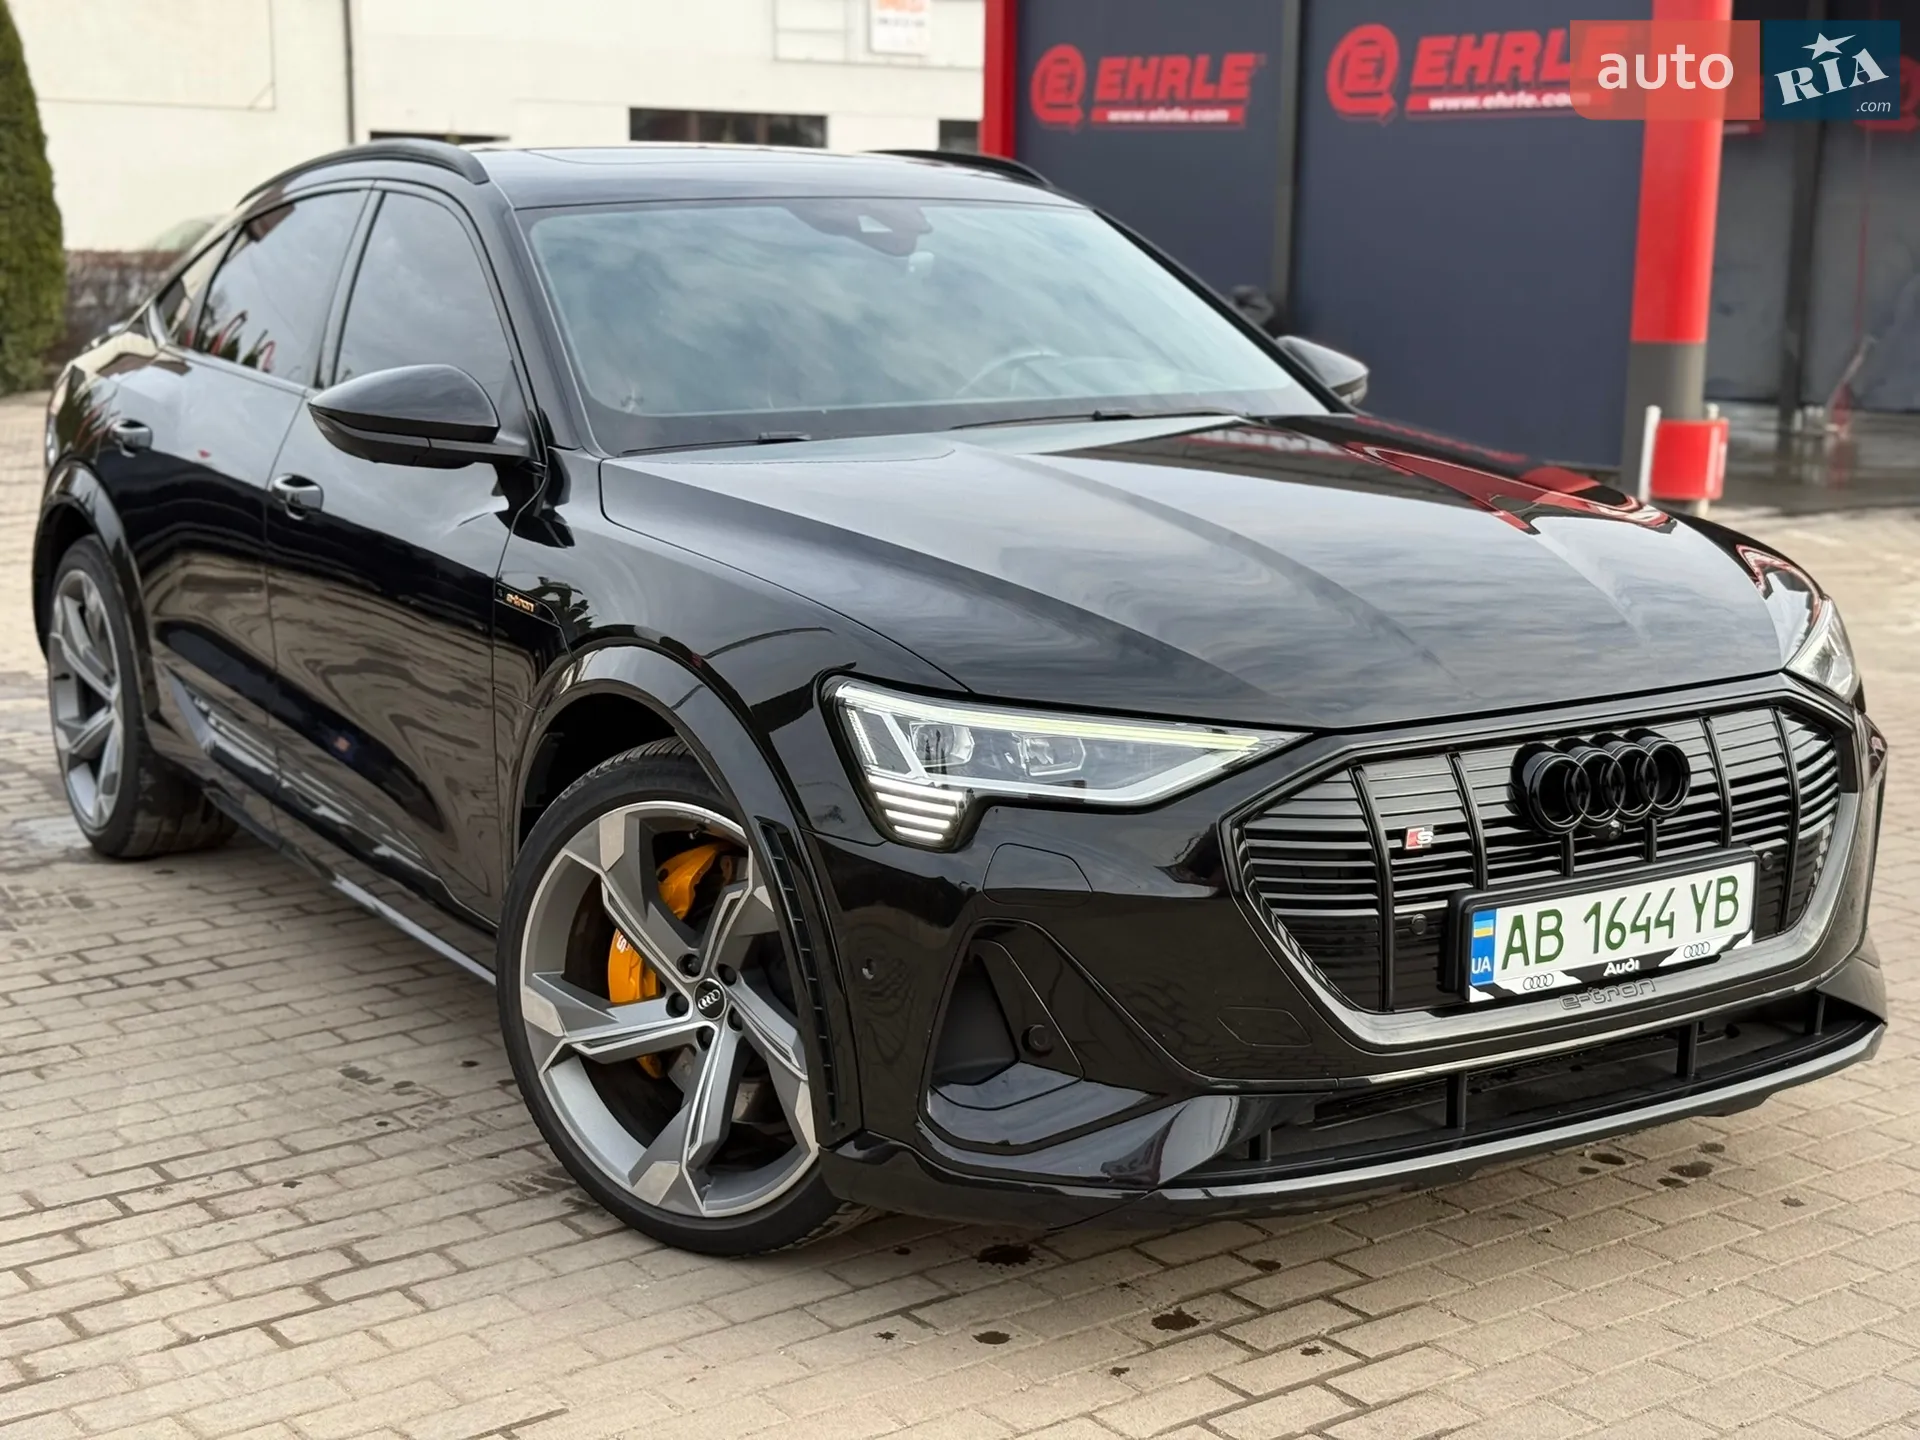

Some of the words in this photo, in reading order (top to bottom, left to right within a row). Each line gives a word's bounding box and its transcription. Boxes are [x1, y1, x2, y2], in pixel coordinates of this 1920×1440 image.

[1095, 53, 1257, 101] EHRLE
[1501, 908, 1565, 971] AB
[1583, 887, 1676, 954] 1644
[1690, 875, 1740, 933] YB
[1471, 956, 1492, 975] UA
[1603, 957, 1641, 977] Audi
[1560, 978, 1656, 1010] e-tron
